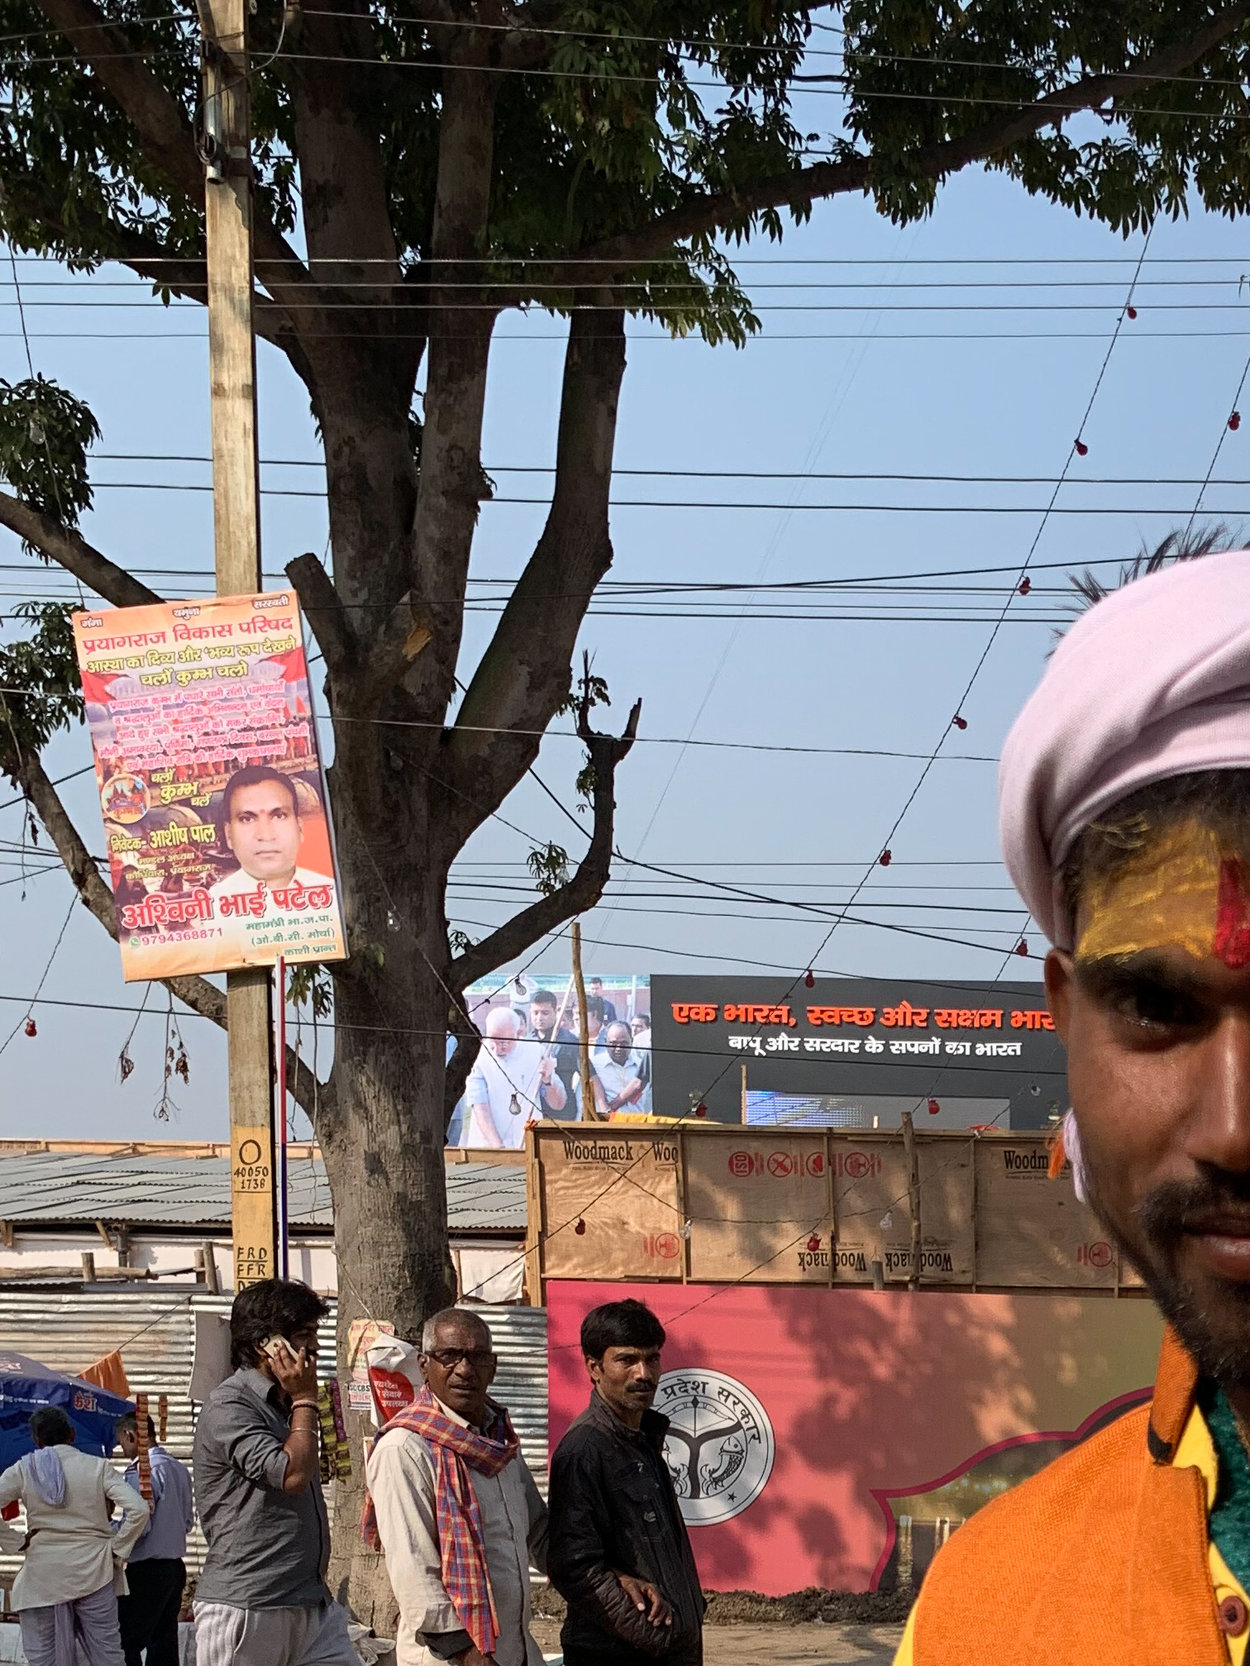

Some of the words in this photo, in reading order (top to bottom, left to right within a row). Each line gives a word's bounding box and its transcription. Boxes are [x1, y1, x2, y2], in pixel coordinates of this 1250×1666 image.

[82, 631, 167, 656] प्रयागराज
[172, 623, 233, 643] विकास
[237, 615, 294, 635] परिषद
[126, 655, 145, 669] का
[147, 649, 176, 667] दिव्य
[178, 645, 203, 663] और
[262, 635, 297, 653] देखने
[175, 667, 214, 687] कुम्भ
[160, 781, 199, 804] कुम्भ
[190, 823, 216, 843] पाल
[121, 886, 215, 930] अश्विनी
[219, 881, 268, 918] भाई
[271, 879, 334, 912] पटेल
[142, 927, 224, 946] 9794368871
[671, 1001, 719, 1024] एक
[723, 1002, 797, 1028] भारत,
[806, 1004, 877, 1027] स्वच्छ
[879, 1000, 930, 1029] और
[934, 1008, 1003, 1030] सक्षम
[1009, 1009, 1059, 1031] भार
[728, 1035, 768, 1057] बापू
[765, 1032, 802, 1053] और
[803, 1036, 860, 1055] सरदार
[864, 1034, 885, 1054] के
[890, 1035, 941, 1056] सपनों
[945, 1041, 971, 1057] का
[974, 1041, 1023, 1057] भारत
[563, 1140, 634, 1161] Woodmack
[1004, 1149, 1072, 1170] Woodm
[734, 1154, 748, 1174] ISO
[240, 1178, 266, 1190] 1738
[237, 1246, 268, 1260] FRD
[237, 1263, 266, 1277] FFR
[661, 1378, 709, 1400] प्रदेश
[717, 1385, 762, 1445] सरकार
